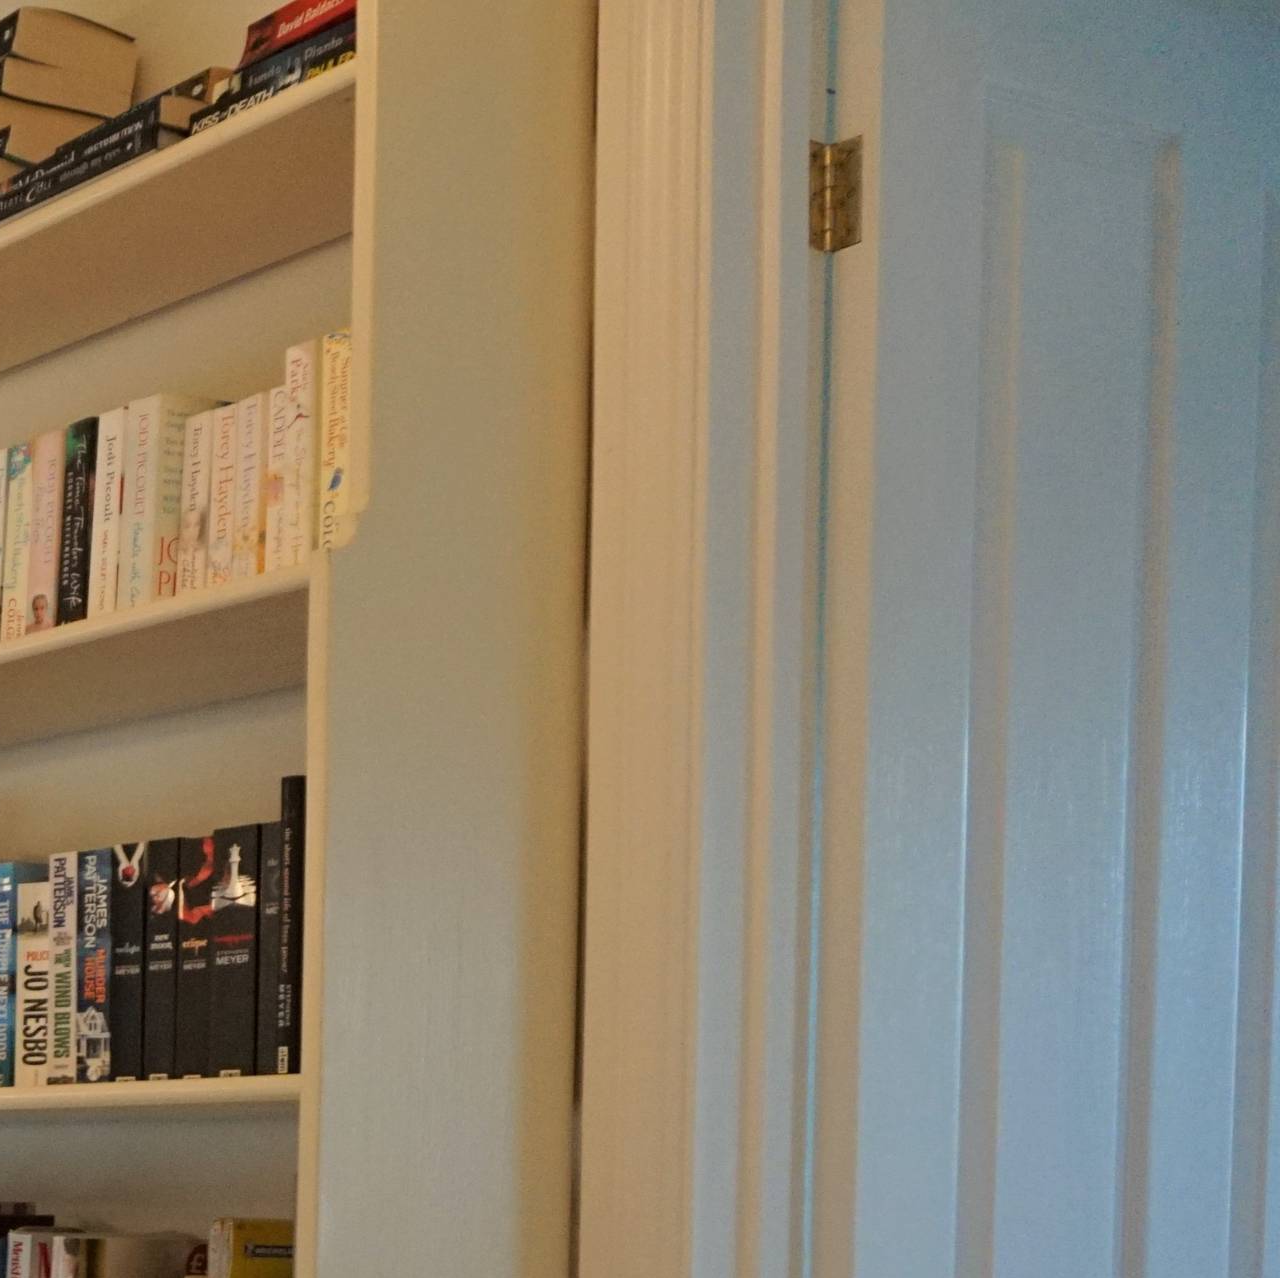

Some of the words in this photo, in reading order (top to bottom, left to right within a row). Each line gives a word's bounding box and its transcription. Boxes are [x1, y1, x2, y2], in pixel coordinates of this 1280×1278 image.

[192, 111, 219, 133] KISS
[227, 89, 274, 120] DEATH
[288, 358, 303, 404] Parks
[106, 435, 118, 466] Jodi
[137, 412, 152, 449] JODI
[215, 413, 235, 459] Torey
[272, 391, 288, 462] CADDLE
[323, 417, 339, 468] Bakery
[103, 471, 117, 523] Picoult
[134, 450, 149, 517] PICOULT
[187, 461, 202, 512] Hayden
[214, 464, 234, 541] Hayden
[239, 451, 257, 529] Hayden
[63, 572, 83, 609] Wife
[52, 857, 68, 929] PATTERSON
[83, 855, 98, 949] PATTERSON
[95, 878, 108, 929] JAMES
[24, 964, 49, 991] JO
[83, 956, 96, 1001] HOUSE
[94, 948, 107, 1004] MURDER
[215, 954, 250, 967] MEYER
[53, 969, 73, 1008] WIND
[22, 998, 48, 1067] NESBO
[52, 1011, 72, 1058] BLOWS
